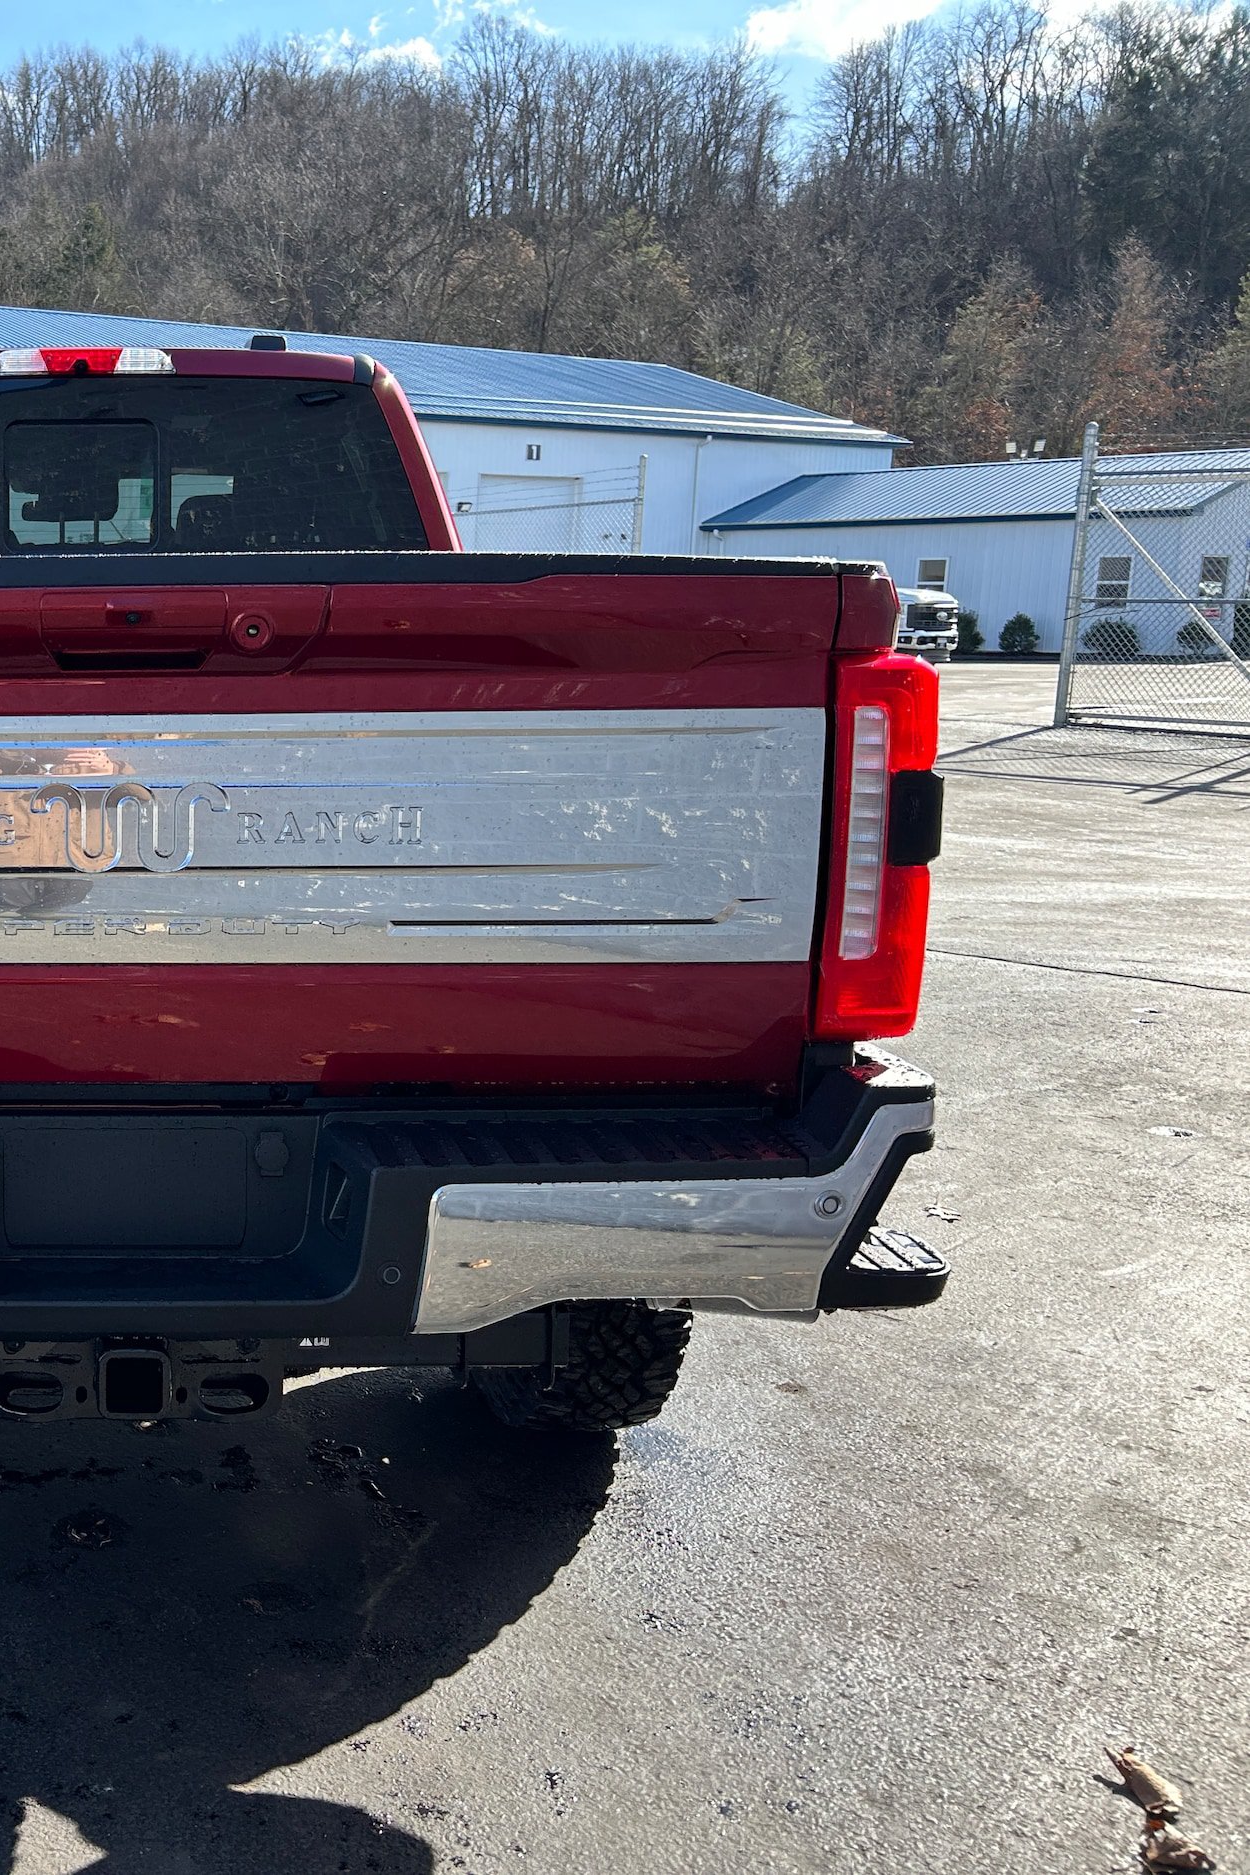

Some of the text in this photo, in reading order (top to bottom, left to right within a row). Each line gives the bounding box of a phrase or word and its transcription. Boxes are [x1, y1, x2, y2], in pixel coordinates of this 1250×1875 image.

[531, 445, 537, 460] 1
[237, 806, 423, 844] RANCH
[168, 918, 361, 935] DUTY
